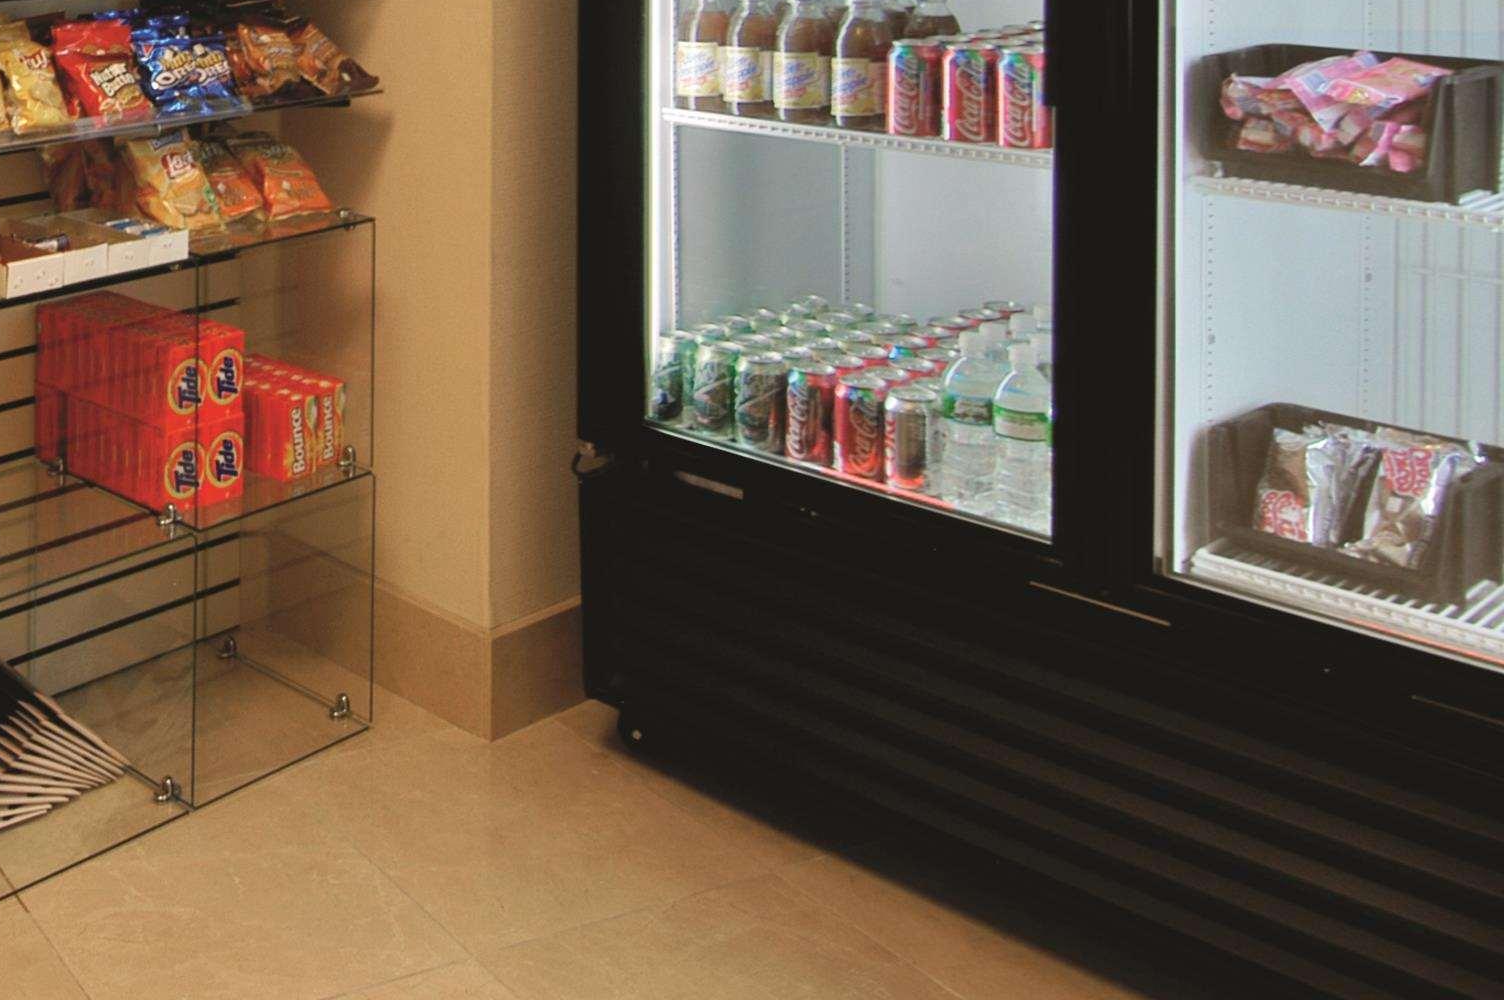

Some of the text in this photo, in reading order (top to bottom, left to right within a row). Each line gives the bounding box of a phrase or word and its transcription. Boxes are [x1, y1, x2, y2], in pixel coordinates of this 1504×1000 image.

[177, 366, 202, 409] Tide
[216, 356, 239, 399] Tide
[291, 406, 307, 474] Bounce
[321, 395, 334, 460] Bounce
[173, 450, 200, 493] Tide
[215, 439, 239, 481] Tide
